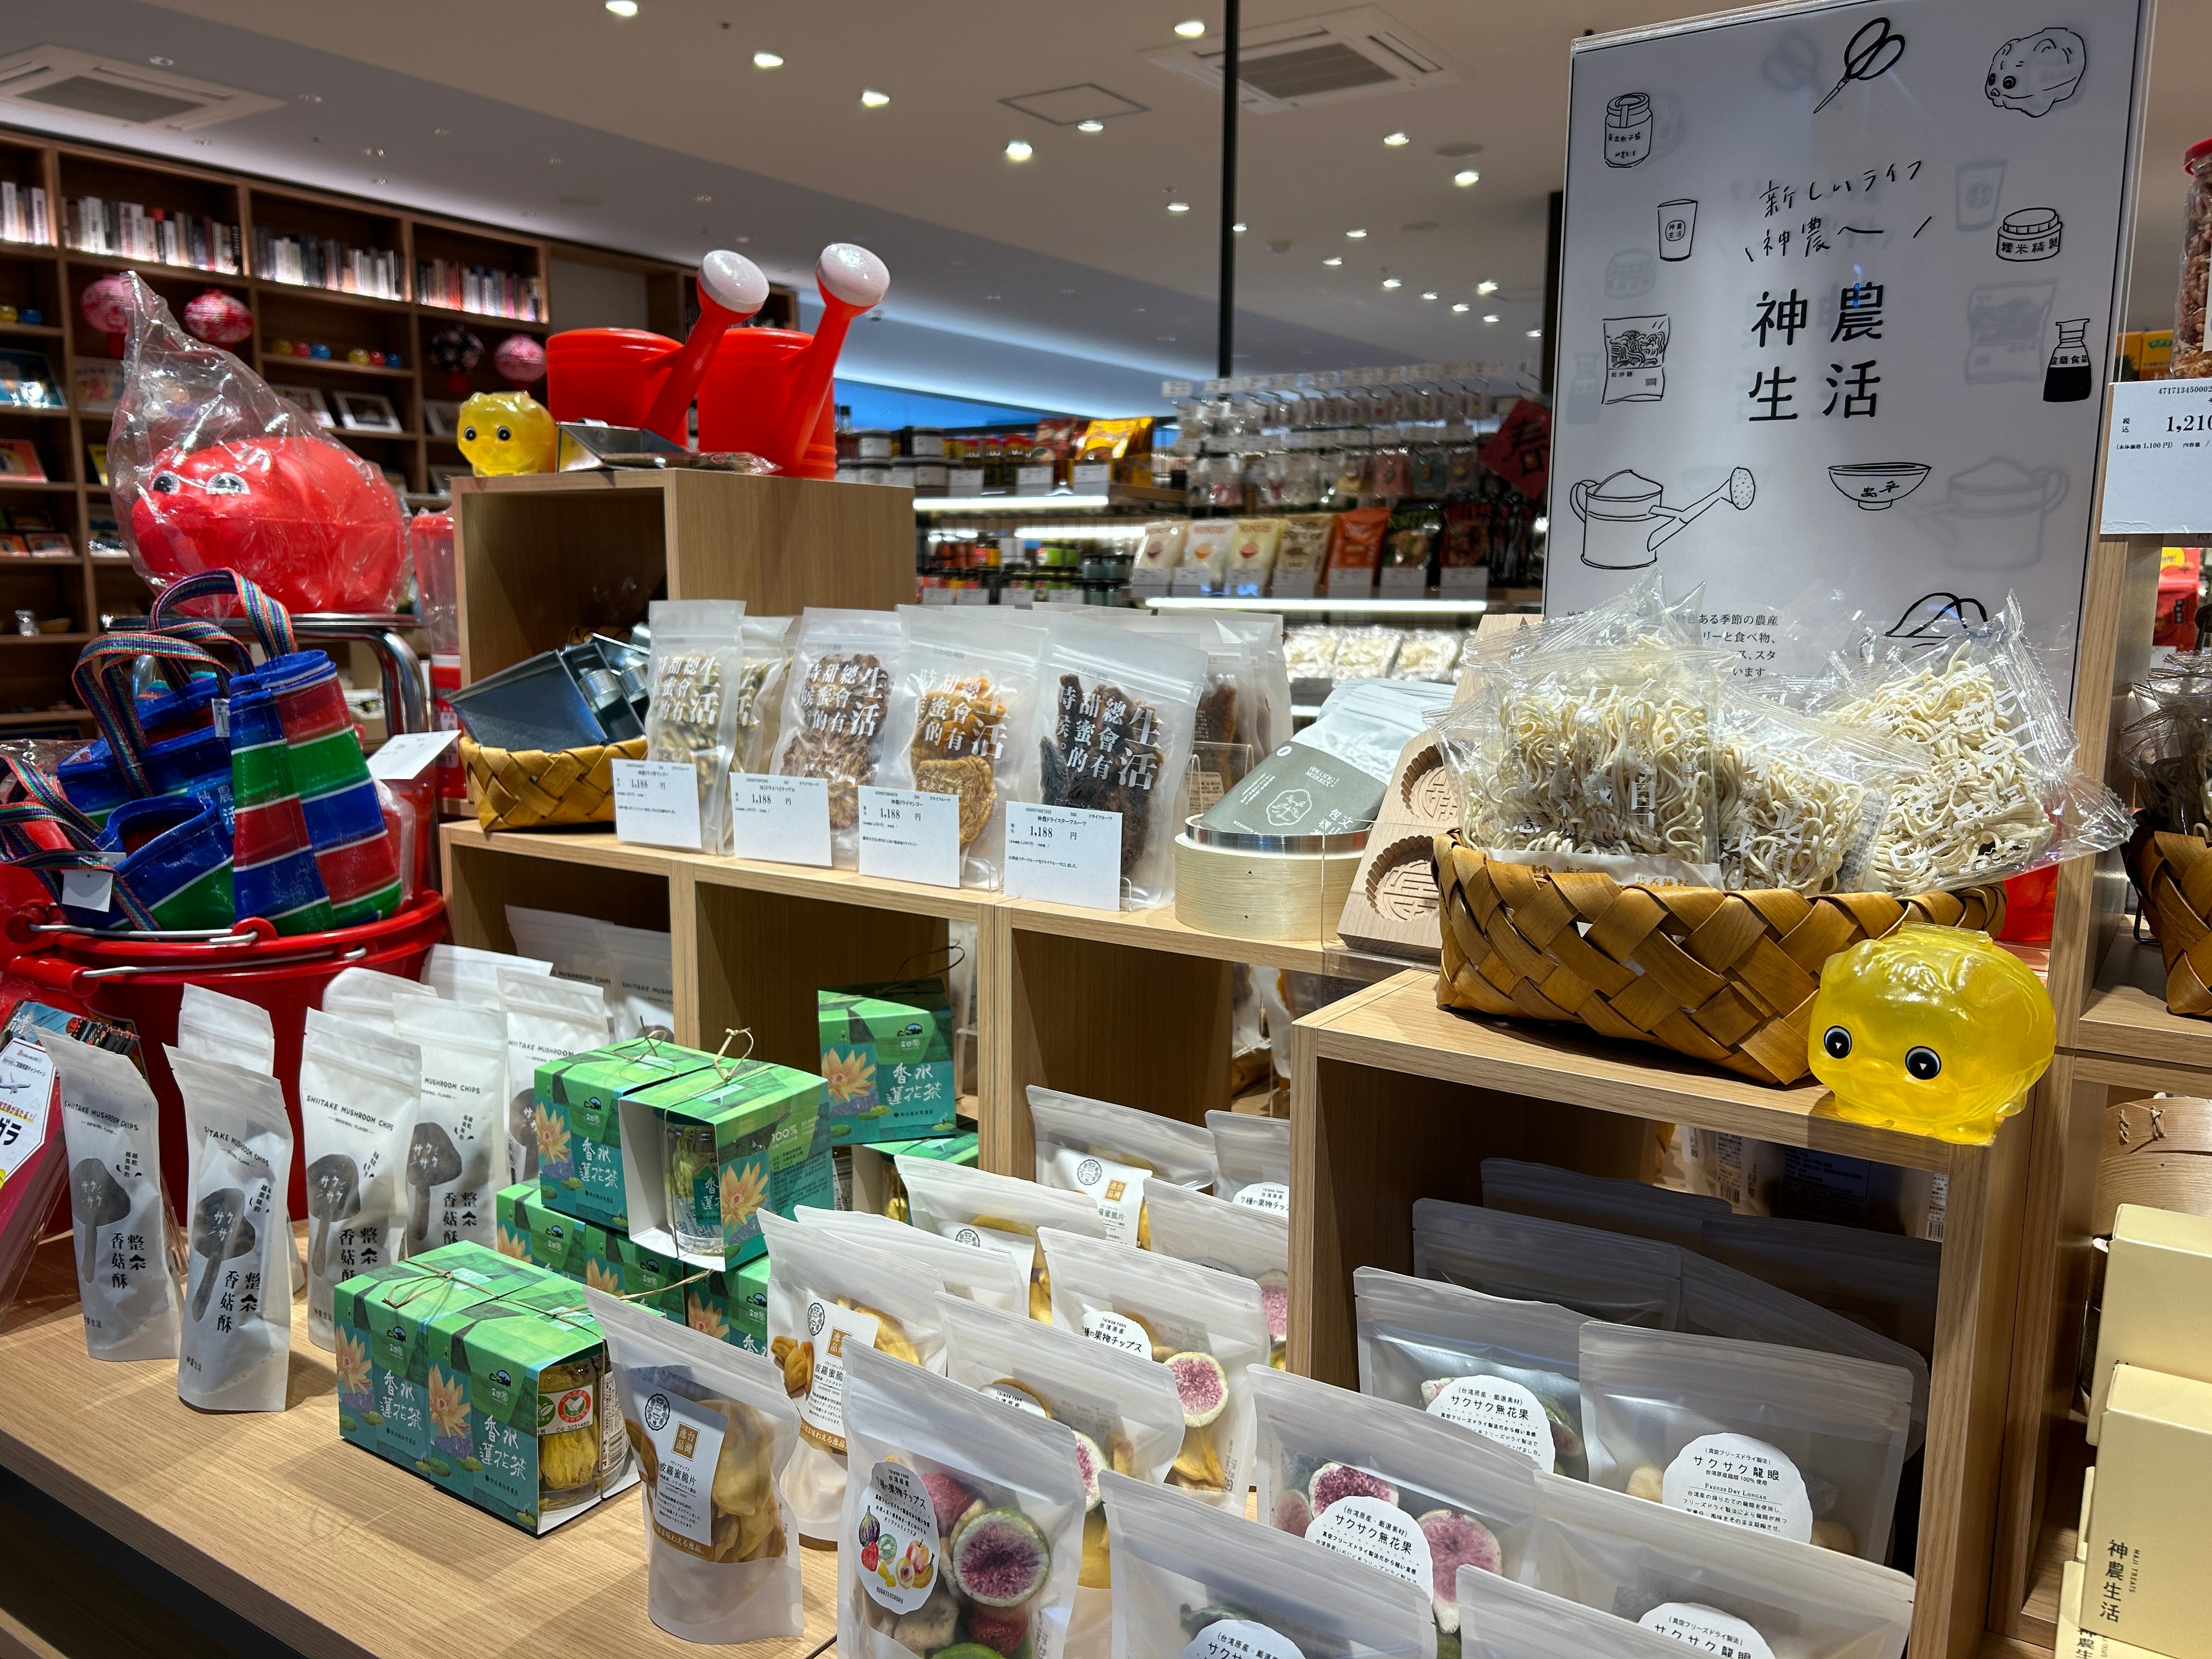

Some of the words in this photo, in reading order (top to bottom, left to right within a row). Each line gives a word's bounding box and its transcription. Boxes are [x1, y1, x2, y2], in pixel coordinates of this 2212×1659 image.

[1759, 161, 1921, 217] 新しいライフ
[1118, 707, 1164, 790] 生活
[631, 779, 648, 789] 1,188
[752, 794, 771, 804] 1,188
[880, 808, 900, 819] 1,188
[1030, 826, 1053, 838] 1,188
[1070, 831, 1077, 840] 円
[425, 1077, 457, 1090] MUSHROOM
[461, 1084, 480, 1095] CHIPS
[64, 1100, 89, 1115] SHIITAKE
[91, 1109, 120, 1125] MUSHROOM
[120, 1119, 139, 1132] CHIPS
[306, 1095, 338, 1111] SHIITAKE
[341, 1107, 376, 1124] MUSHROOM
[379, 1119, 394, 1132] CHIPS
[771, 1124, 798, 1142] 100%
[1082, 1325, 1142, 1352] 種の果物チップス
[384, 1369, 415, 1401] 香水
[380, 1396, 422, 1430] 蓮花茶
[1450, 1395, 1529, 1420] サクサク無花果
[484, 1414, 519, 1449] 香水
[479, 1441, 526, 1480] 蓮花茶
[1693, 1455, 1779, 1481] サクサク龍眼
[1704, 1483, 1727, 1493] FREEZE
[1728, 1487, 1741, 1496] DRY
[1335, 1514, 1412, 1555] サクサク無花果
[2099, 1539, 2128, 1623] 神農生活
